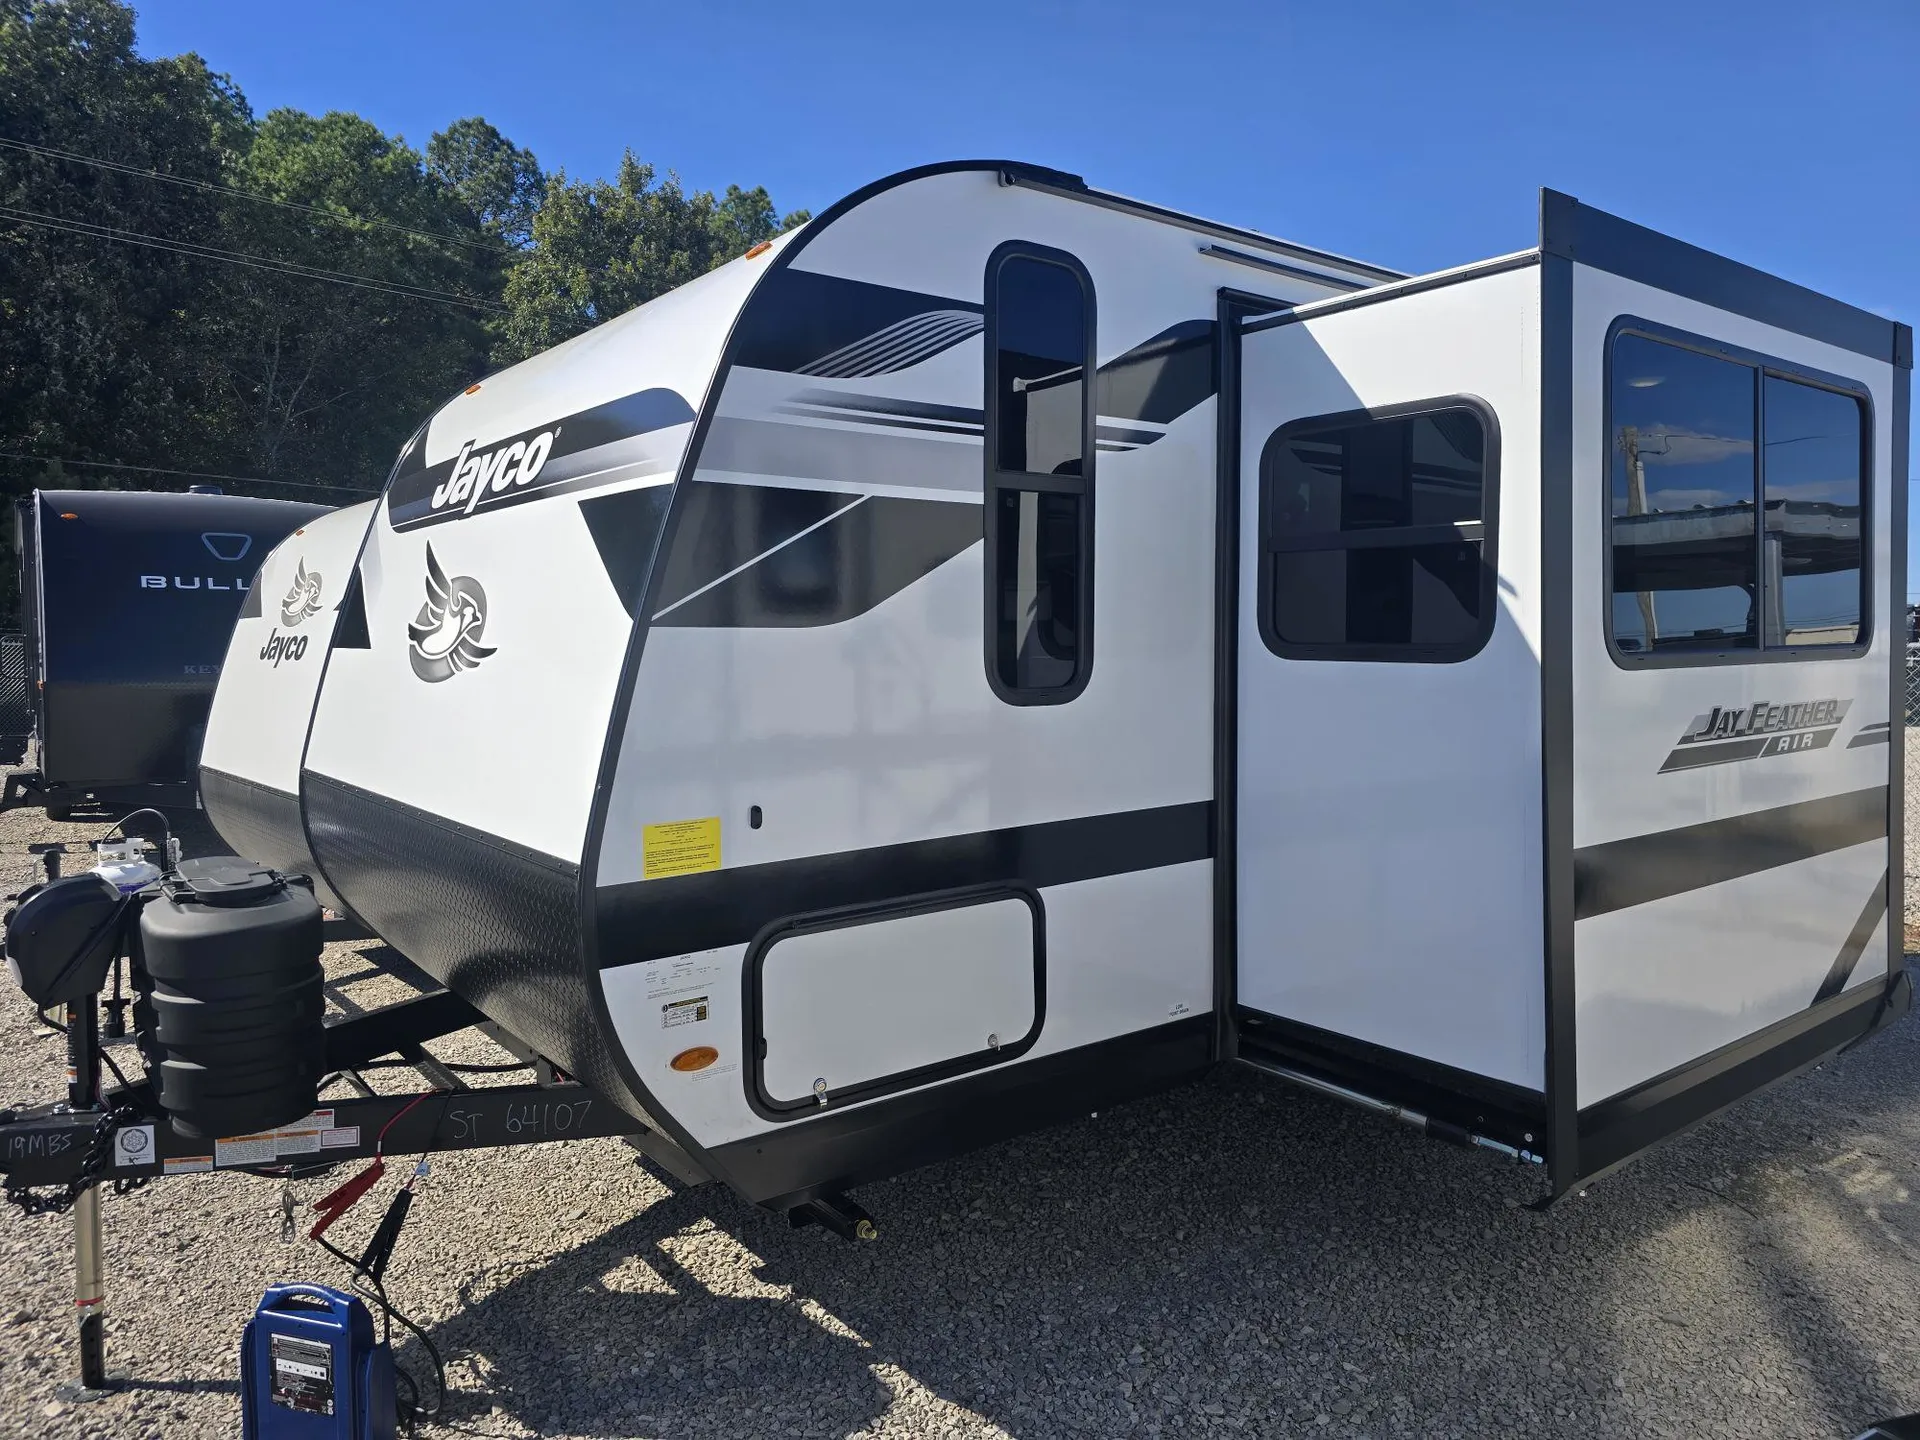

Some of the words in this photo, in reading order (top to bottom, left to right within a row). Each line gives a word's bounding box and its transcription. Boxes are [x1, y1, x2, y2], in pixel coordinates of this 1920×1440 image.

[431, 431, 554, 515] Jayco
[140, 575, 250, 590] BULL
[259, 627, 309, 669] Jayco
[1694, 704, 1746, 741] JAY
[1745, 698, 1839, 734] FEATHER
[1776, 732, 1814, 752] AIR
[450, 1110, 484, 1142] ST
[506, 1100, 592, 1135] 64107
